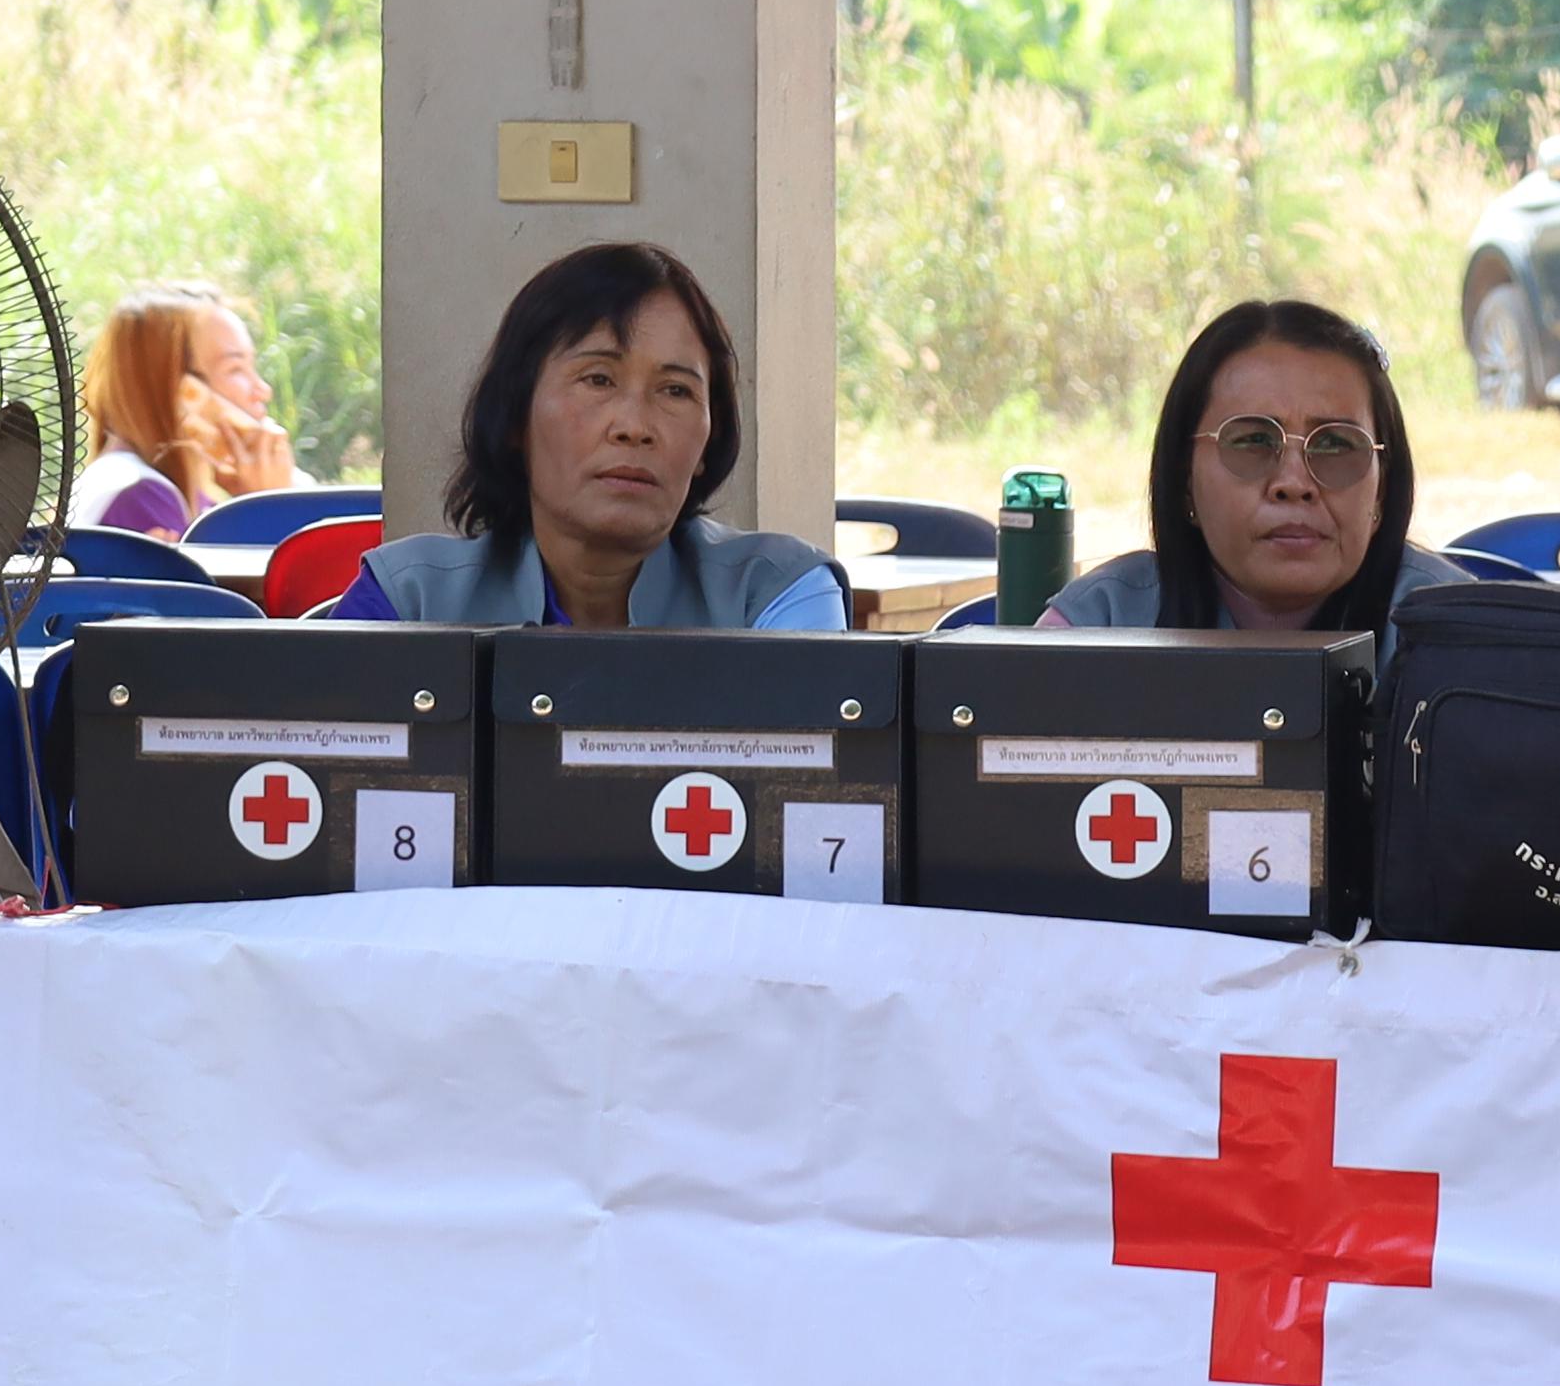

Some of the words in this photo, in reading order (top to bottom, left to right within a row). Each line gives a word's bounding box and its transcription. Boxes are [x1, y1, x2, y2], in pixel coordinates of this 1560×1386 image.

[158, 724, 225, 741] ห้องพยาบาล
[579, 737, 646, 753] ห้องพยาบาล
[999, 745, 1067, 762] ห้องพยาบาล
[393, 825, 416, 861] 8
[822, 837, 846, 873] 7
[1248, 846, 1271, 882] 6
